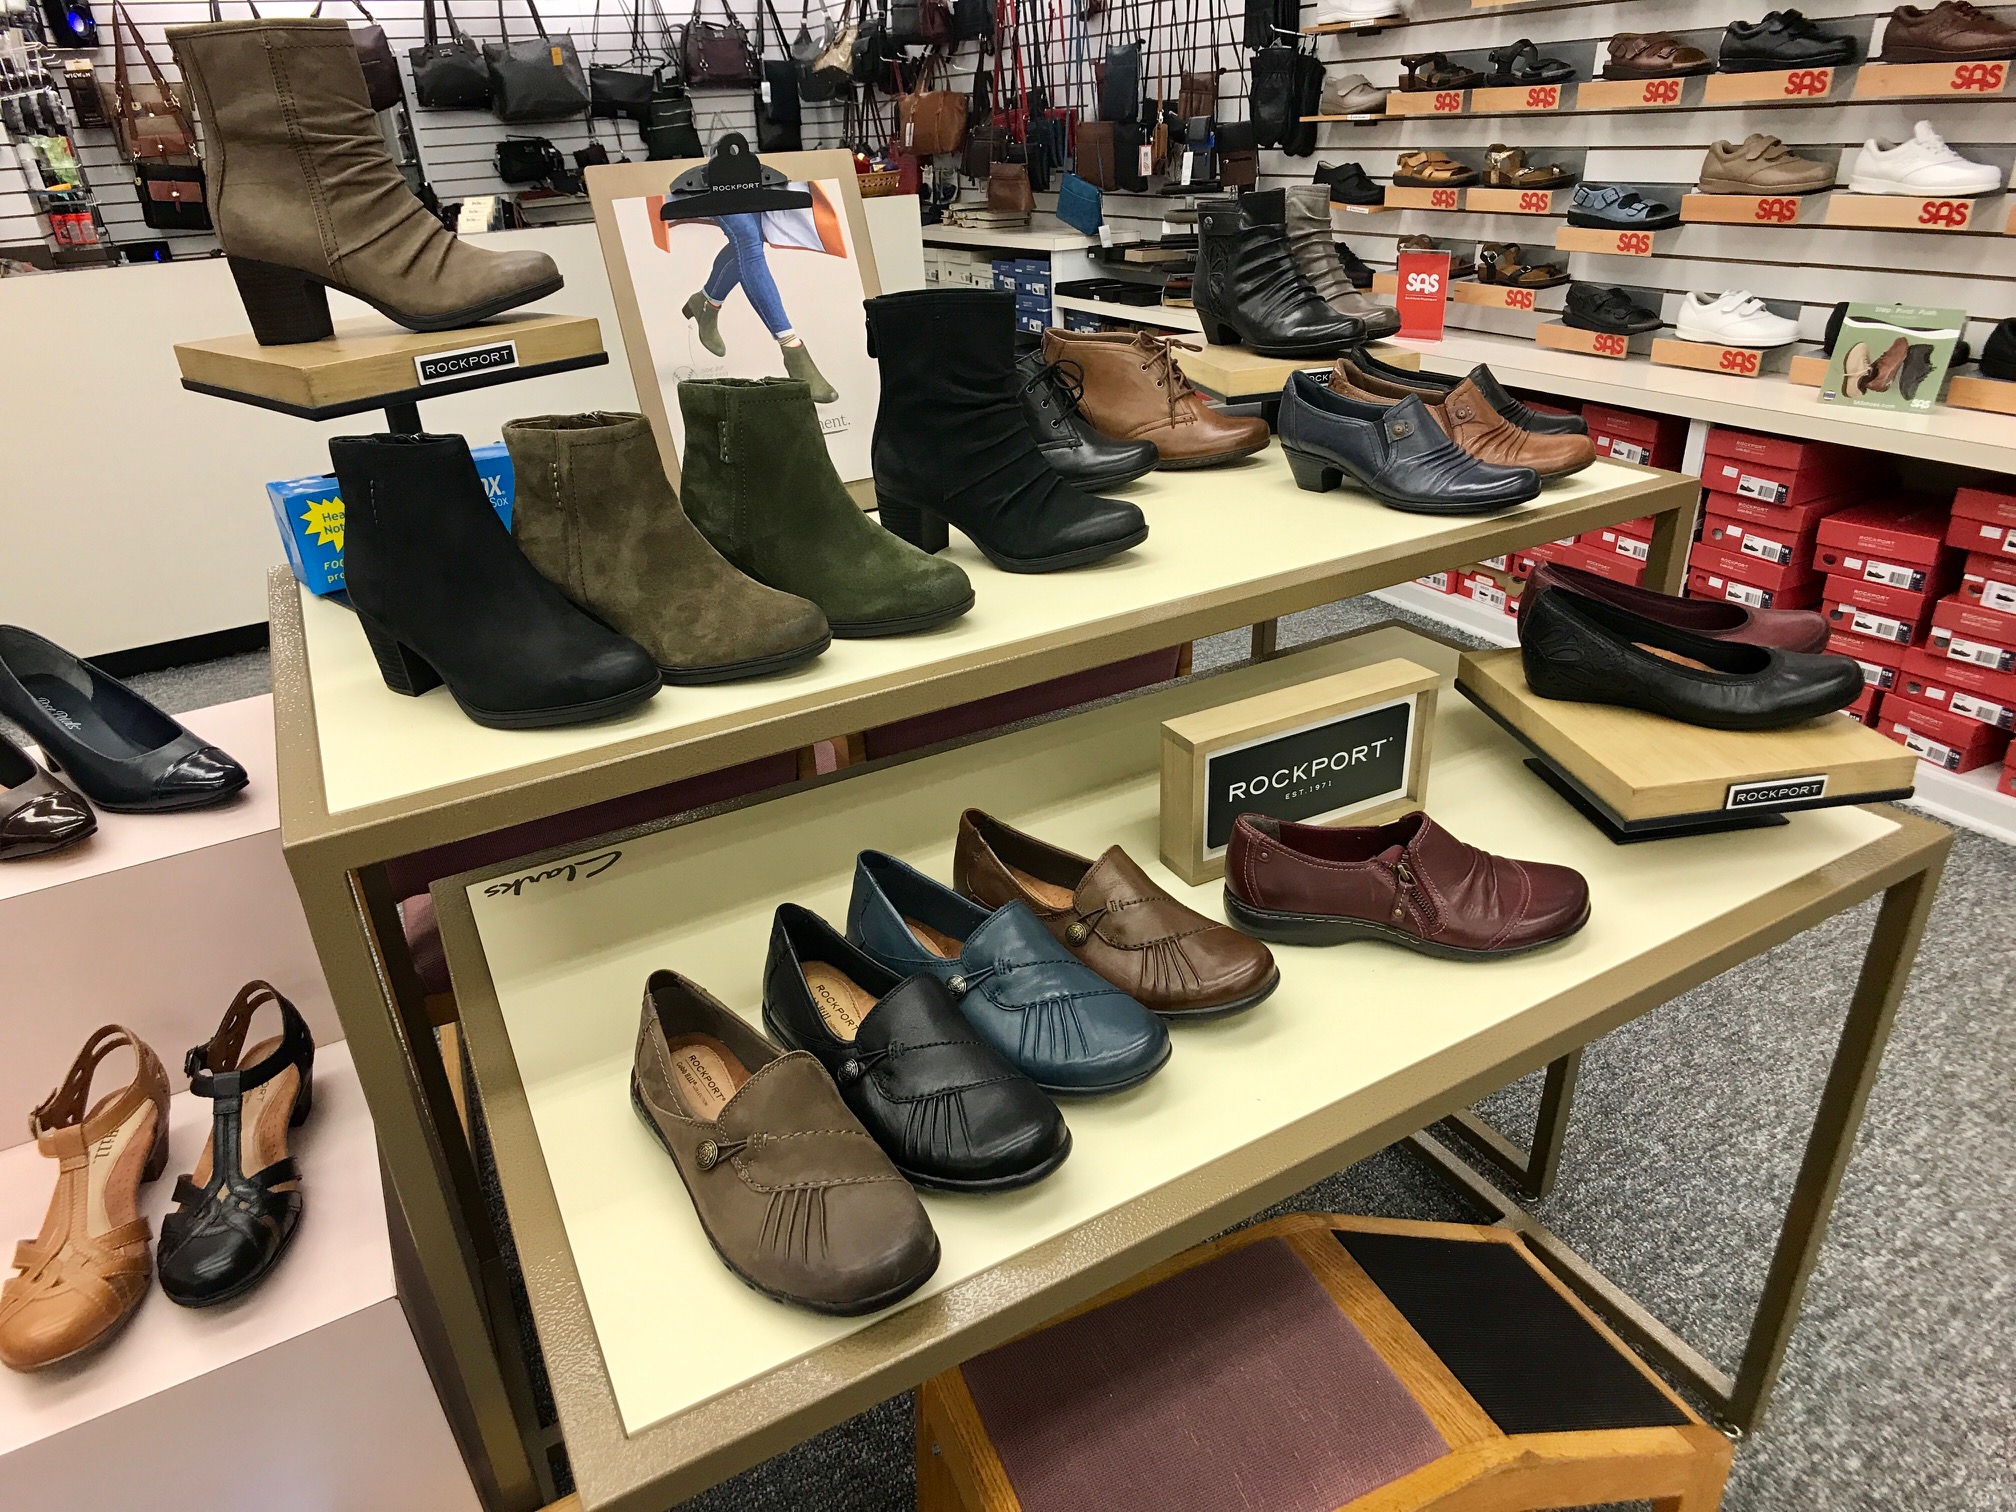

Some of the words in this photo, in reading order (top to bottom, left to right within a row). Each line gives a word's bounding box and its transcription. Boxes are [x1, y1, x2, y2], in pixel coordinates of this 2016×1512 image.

[1784, 70, 1828, 96] SAS
[1951, 64, 2003, 91] SAS
[1433, 92, 1460, 112] SAS
[1526, 87, 1557, 107] SAS
[1642, 80, 1679, 104] SAS
[712, 182, 760, 192] ROCKPORT
[1430, 190, 1456, 209] SAS
[1519, 192, 1549, 212] SAS
[1754, 198, 1797, 223] SAS
[1918, 201, 1969, 227] SAS
[1616, 233, 1650, 254] SAS
[1406, 272, 1440, 294] SAS
[1504, 289, 1533, 309] SAS
[1592, 334, 1625, 355] SAS
[425, 349, 510, 376] ROCKPORT
[1718, 350, 1758, 373] SAS
[1228, 739, 1388, 803] ROCKPORT
[1736, 784, 1820, 803] ROCKPORT
[484, 850, 623, 898] Clarks
[816, 984, 860, 1031] ROCKPORT
[688, 1054, 725, 1099] ROCKPORT
